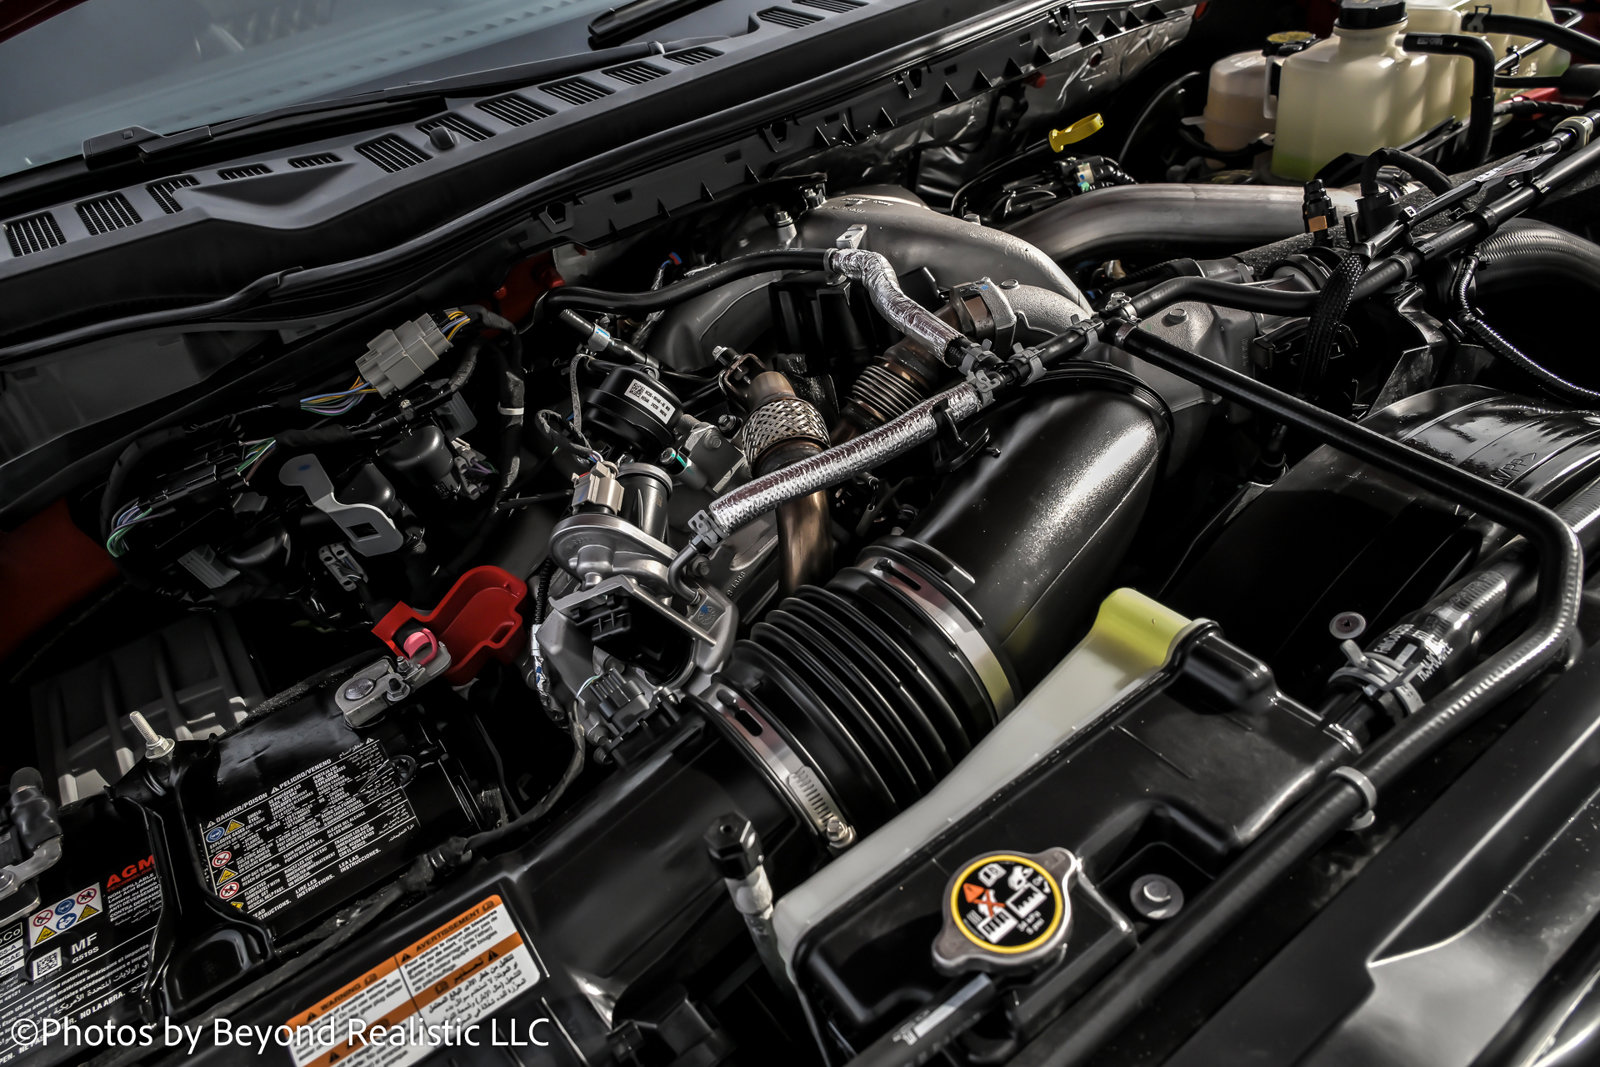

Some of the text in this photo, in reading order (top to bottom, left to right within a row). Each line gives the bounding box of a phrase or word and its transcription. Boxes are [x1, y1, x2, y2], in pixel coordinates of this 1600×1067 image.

[280, 758, 331, 790] PELIGRO/VENENO
[216, 792, 267, 823] DANGER/POISON
[106, 855, 155, 889] AGM
[339, 854, 359, 868] LEA LAS
[296, 878, 317, 894] LIRE LES
[71, 933, 98, 955] MF
[414, 908, 482, 952] AVERTISSEMENT
[80, 1009, 91, 1019] NO
[92, 1002, 102, 1013] LA
[103, 990, 125, 1007] ABRA.
